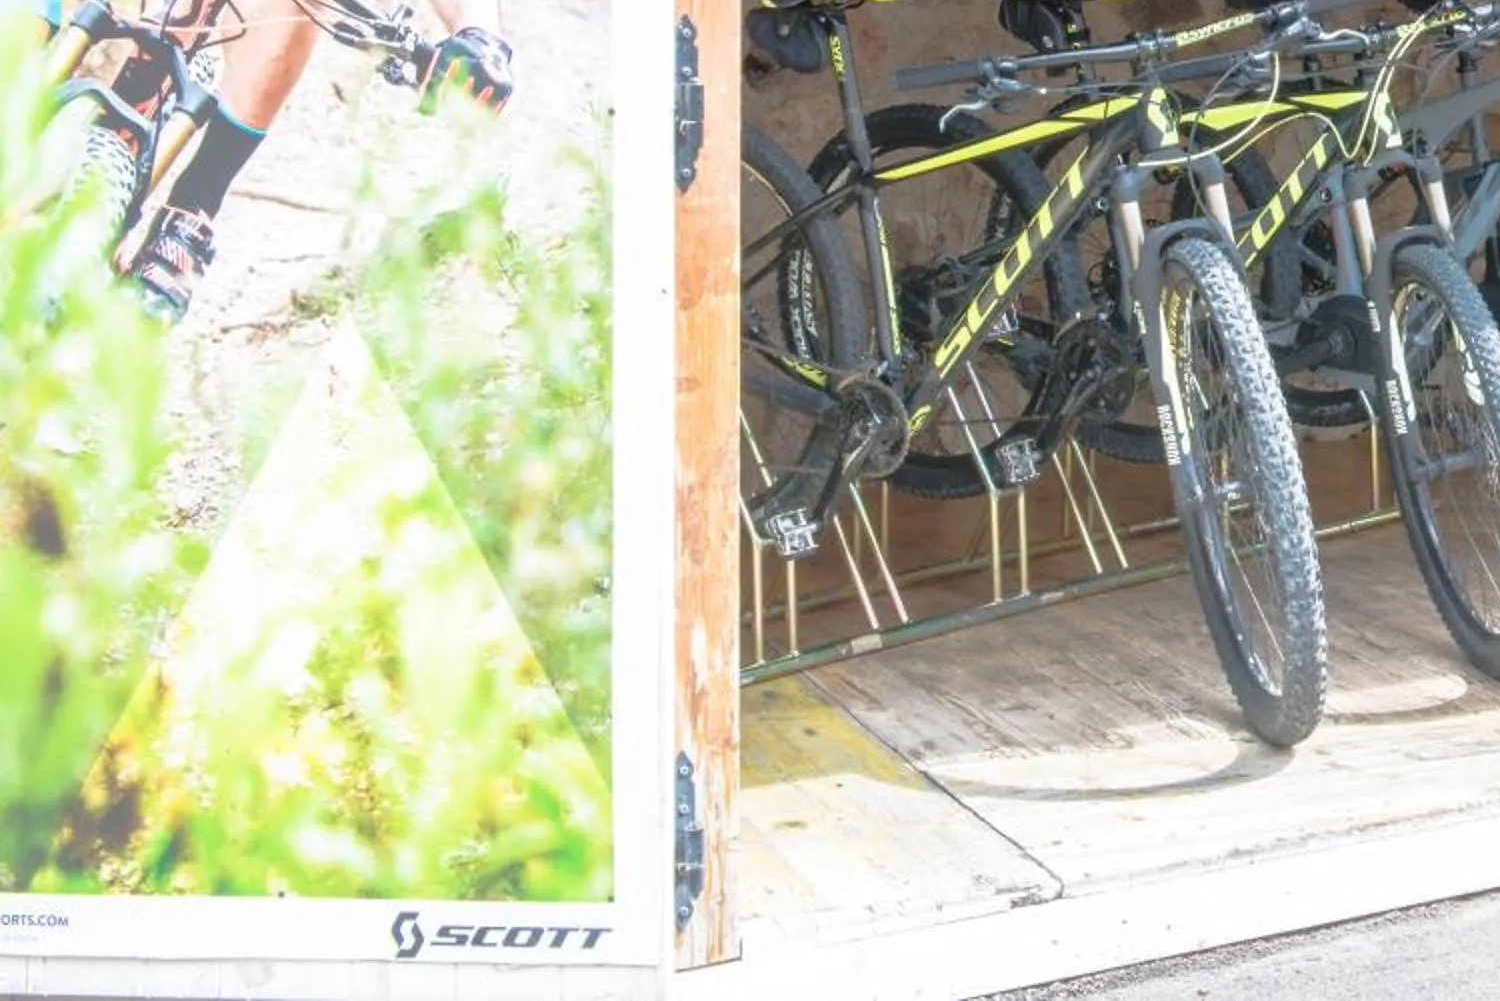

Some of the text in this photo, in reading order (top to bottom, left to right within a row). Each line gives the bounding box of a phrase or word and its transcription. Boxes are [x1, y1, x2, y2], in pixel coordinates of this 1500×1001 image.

[1236, 132, 1328, 267] OTT
[934, 145, 1089, 379] SCOTT
[0, 914, 70, 927] ORTS.COM
[430, 925, 613, 948] SCOTT
